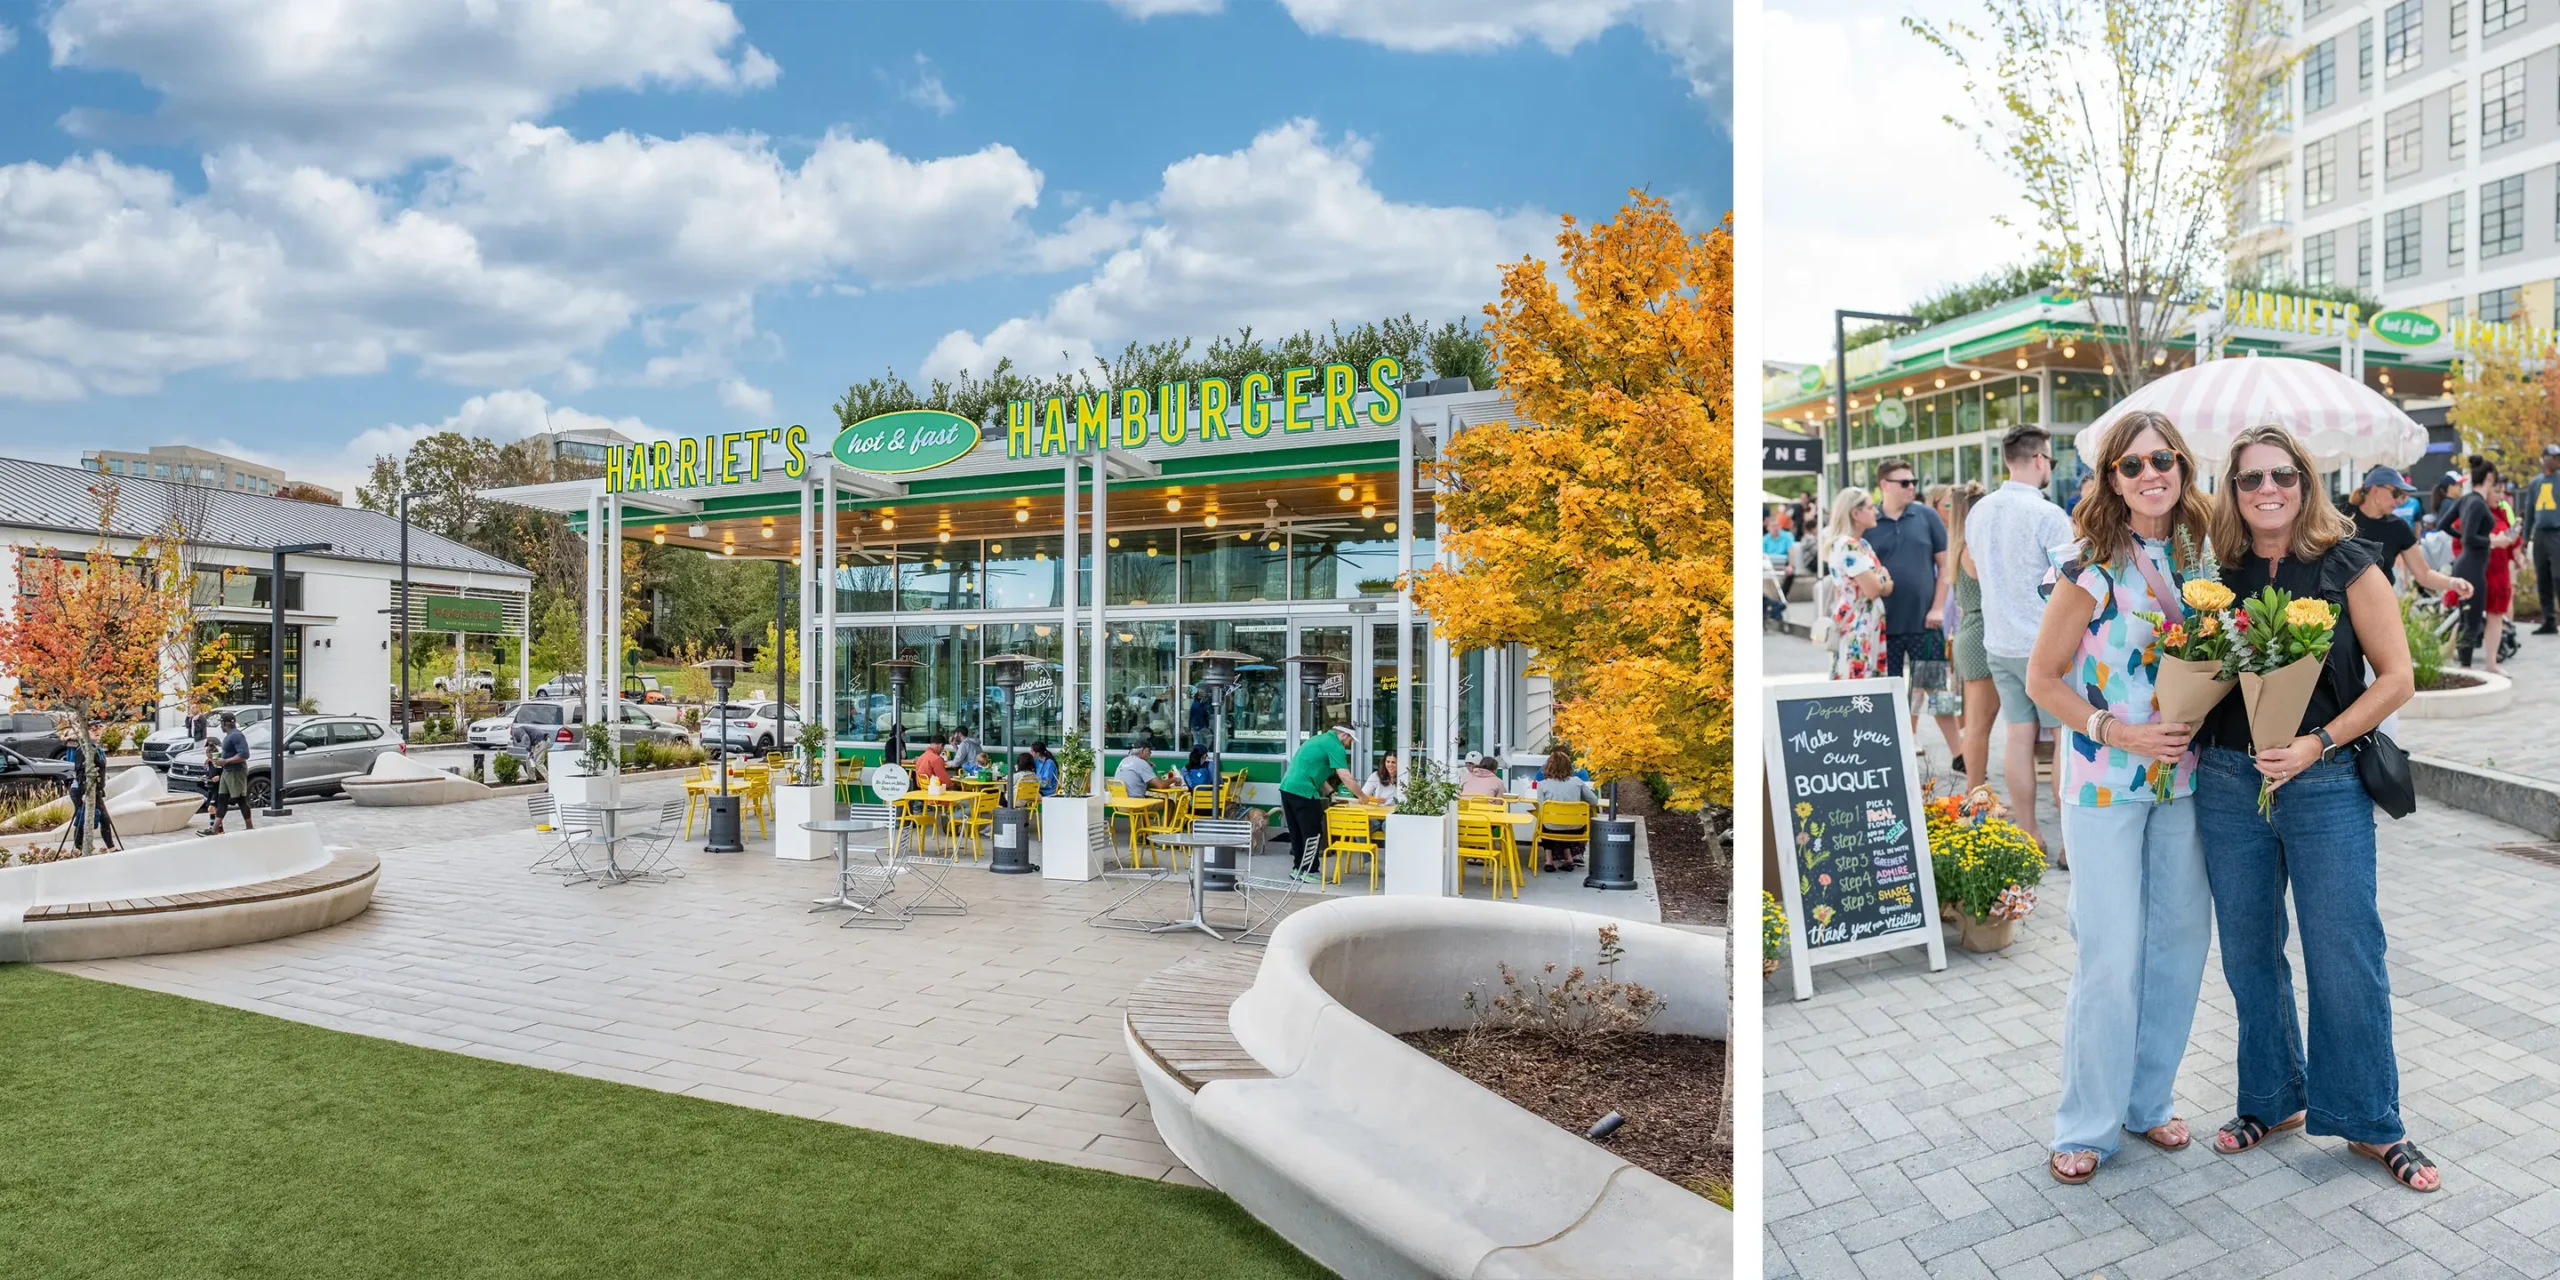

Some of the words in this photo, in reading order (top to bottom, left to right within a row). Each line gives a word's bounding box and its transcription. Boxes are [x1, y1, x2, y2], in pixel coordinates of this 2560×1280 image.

[2226, 287, 2360, 339] HARRIET'S
[2401, 318, 2411, 334] &
[1006, 355, 1403, 460] HAMBURGERS
[847, 430, 885, 455] hot
[887, 427, 906, 451] &
[909, 422, 959, 455] fast
[605, 424, 809, 495] HARRIET'S
[2535, 482, 2557, 511] A
[1788, 729, 1838, 754] Make
[1852, 729, 1892, 748] your
[1822, 752, 1867, 765] own
[1794, 767, 1892, 797] BOUQUET
[1866, 799, 1884, 809] PICK
[1886, 799, 1893, 807] A
[1876, 865, 1909, 879] ADMIRE
[1878, 885, 1910, 901] SHARE
[1909, 882, 1916, 893] &
[1895, 894, 1914, 905] TAG
[1808, 922, 1849, 945] thank
[1851, 921, 1872, 941] you
[1885, 912, 1922, 930] visiting
